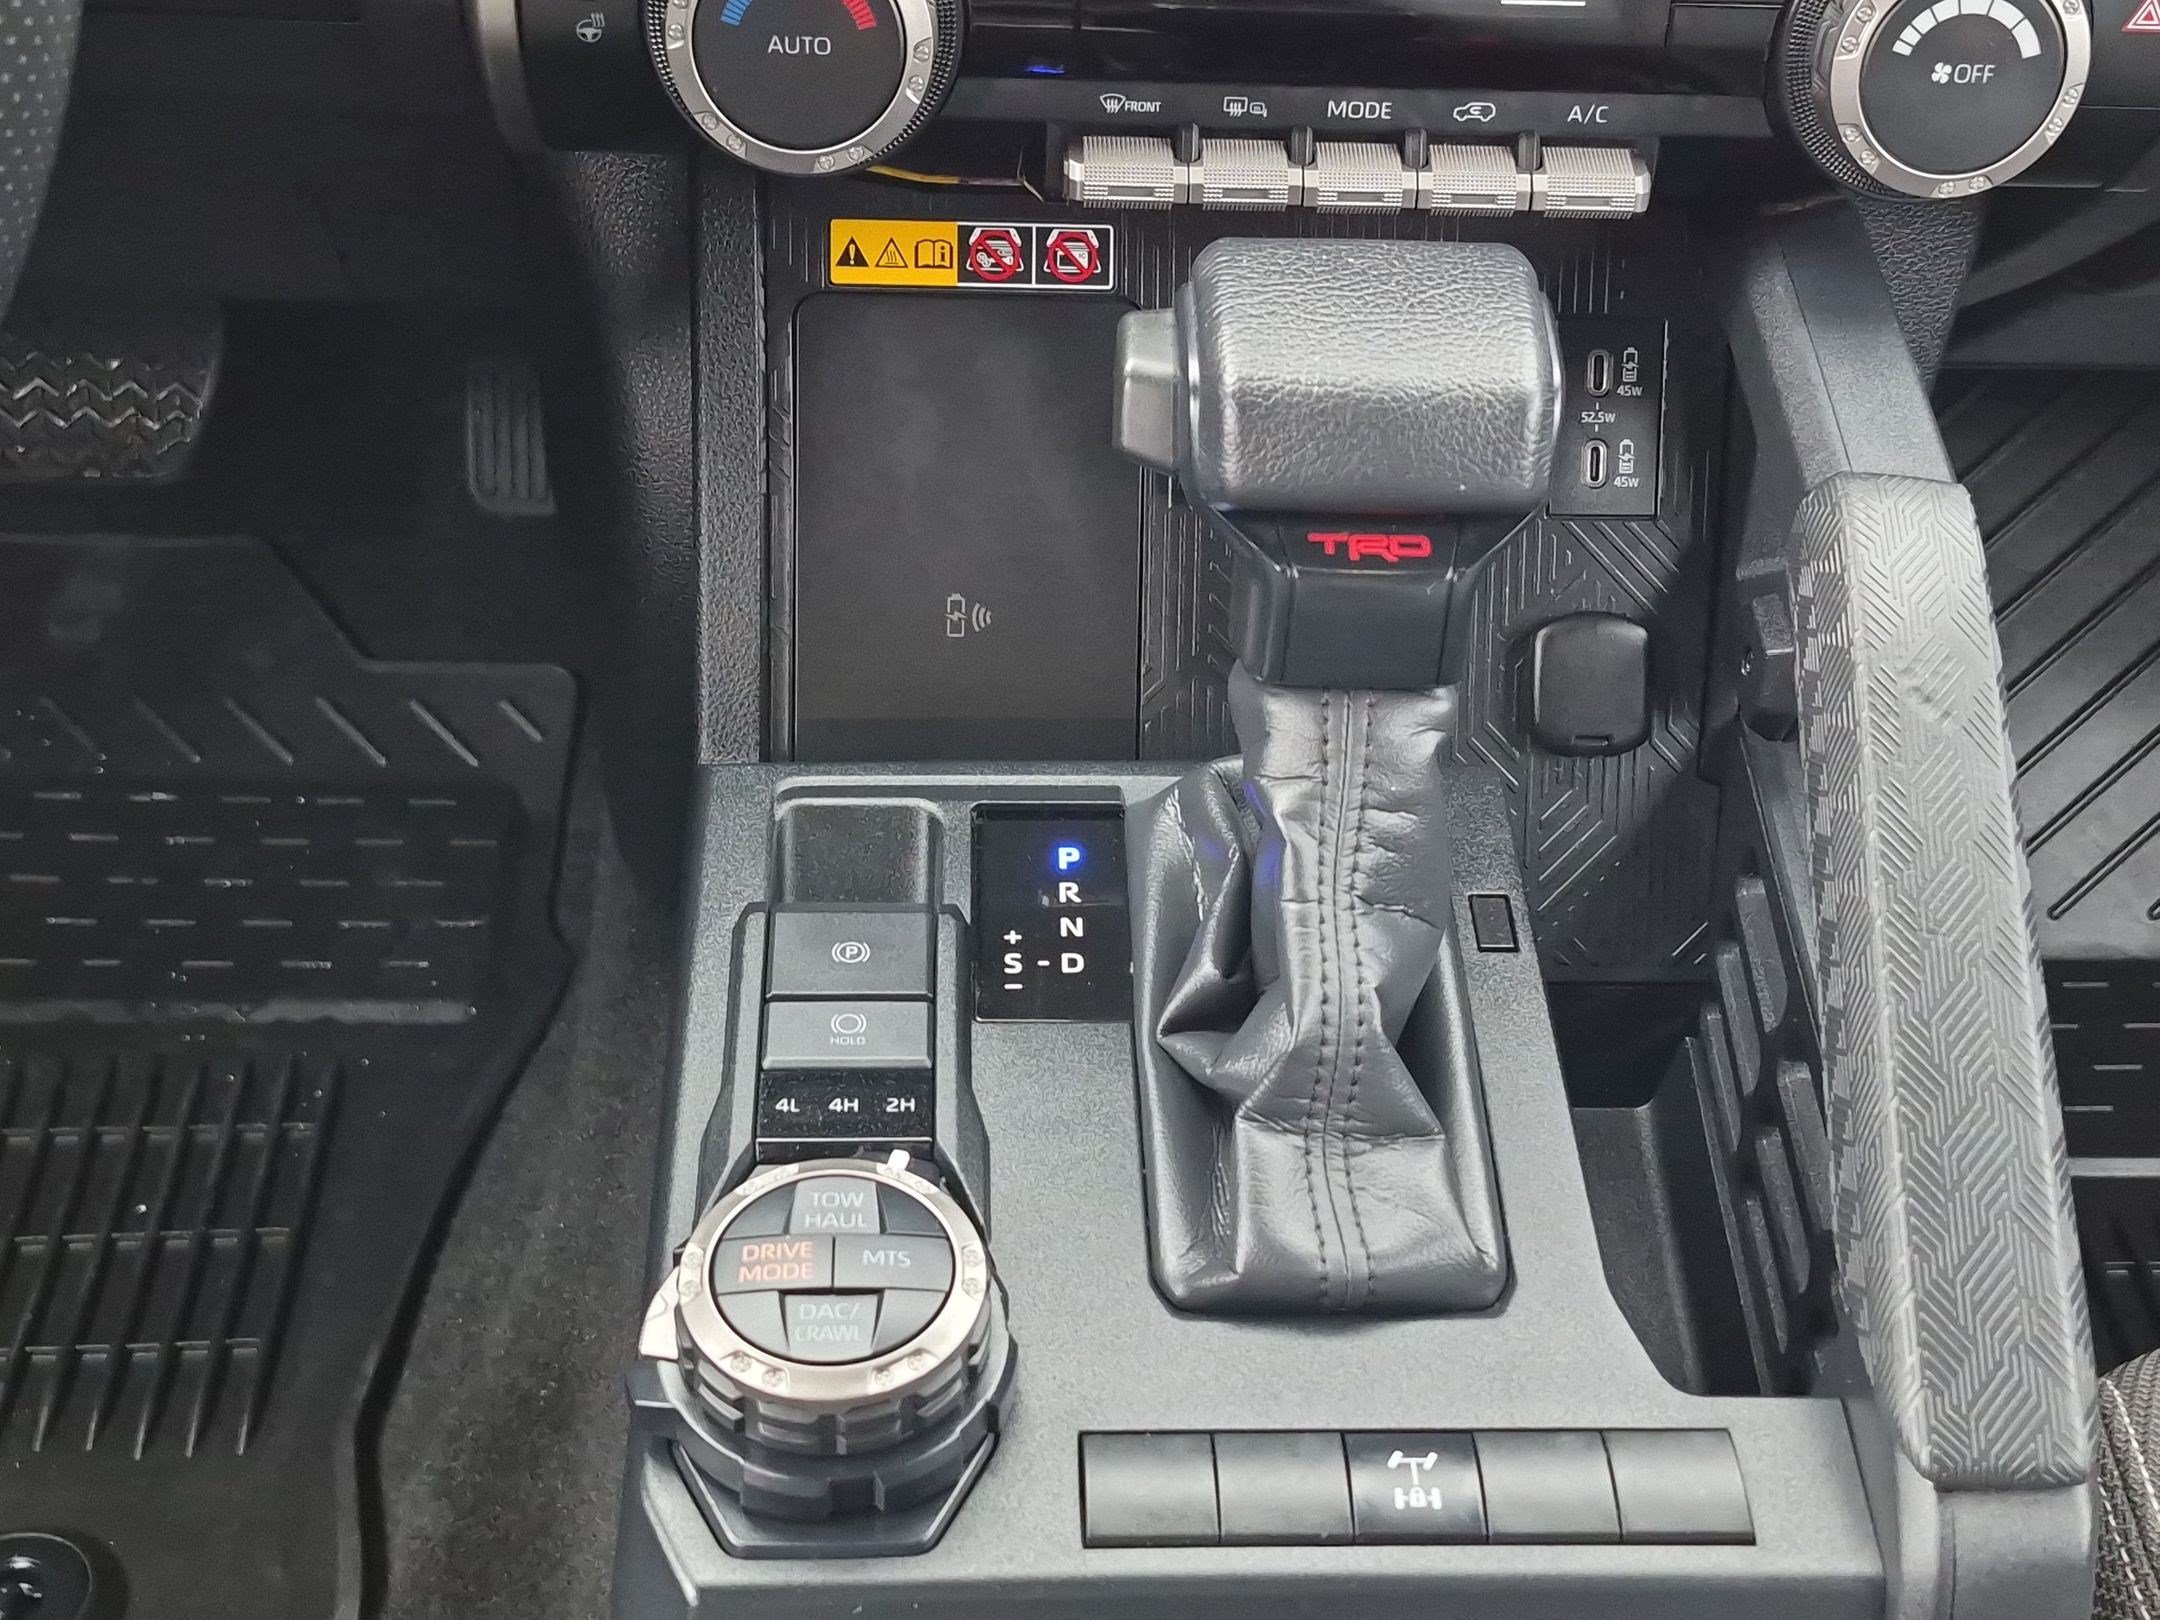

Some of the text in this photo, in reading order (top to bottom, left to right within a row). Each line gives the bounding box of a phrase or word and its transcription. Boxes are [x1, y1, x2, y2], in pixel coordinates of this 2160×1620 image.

[767, 34, 832, 55] AUTO
[1953, 64, 1995, 84] OFF
[1124, 101, 1162, 113] FRONT
[1327, 100, 1393, 120] MODE
[1567, 105, 1609, 124] A/C
[1616, 385, 1643, 397] 45W
[1613, 476, 1640, 488] 45W
[1307, 532, 1431, 562] TRD
[1057, 847, 1081, 870] P
[1058, 881, 1083, 903] R
[1060, 917, 1084, 937] N
[1003, 952, 1023, 975] S
[1061, 952, 1085, 974] D
[830, 1036, 866, 1046] HOLD
[775, 1097, 916, 1113] 4L 4H 2H
[811, 1191, 865, 1208] TOW
[804, 1212, 867, 1229] HAUL
[741, 1240, 816, 1264] DRIVE
[861, 1249, 912, 1269] MTS
[738, 1262, 816, 1284] MODE
[799, 1302, 861, 1321] DAC/
[794, 1325, 863, 1343] CRAWL
